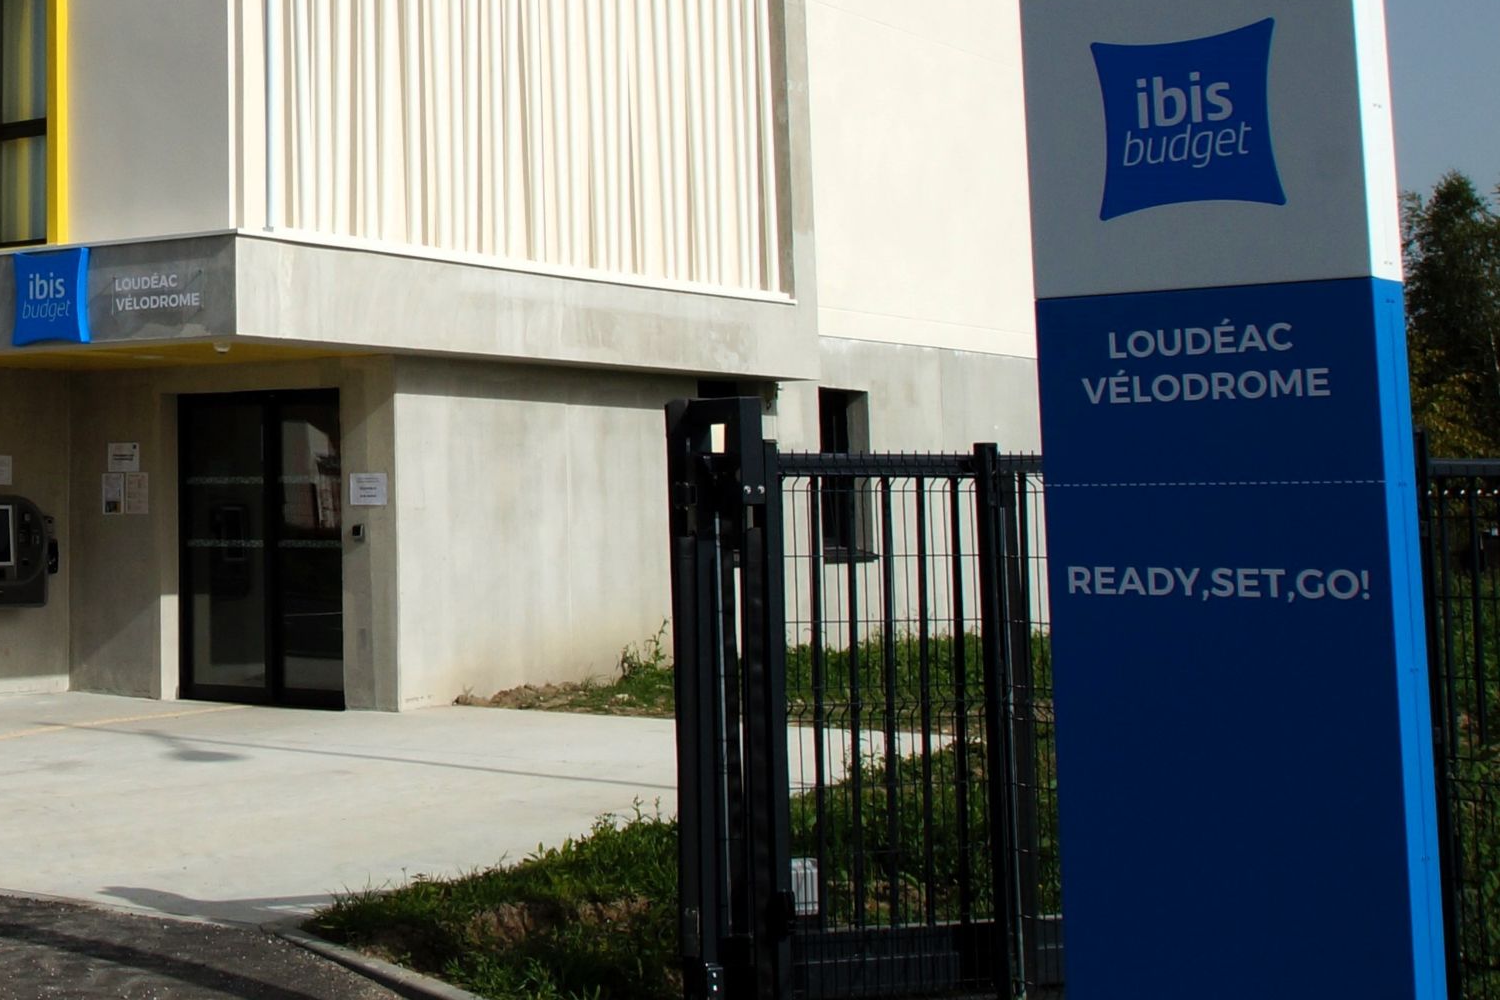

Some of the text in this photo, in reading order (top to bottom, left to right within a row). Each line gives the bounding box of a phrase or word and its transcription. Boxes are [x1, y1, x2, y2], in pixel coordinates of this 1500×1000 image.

[1136, 71, 1233, 129] ibis
[1123, 121, 1252, 168] budget
[29, 272, 65, 299] ibis
[115, 272, 178, 291] LOUDÉAC
[22, 299, 71, 322] budget
[115, 293, 200, 311] VÉLODROME
[1108, 318, 1293, 359] LOUDÉAC
[1081, 367, 1331, 404] VÉLODROME
[1067, 566, 1370, 603] READY,SET,GO!
